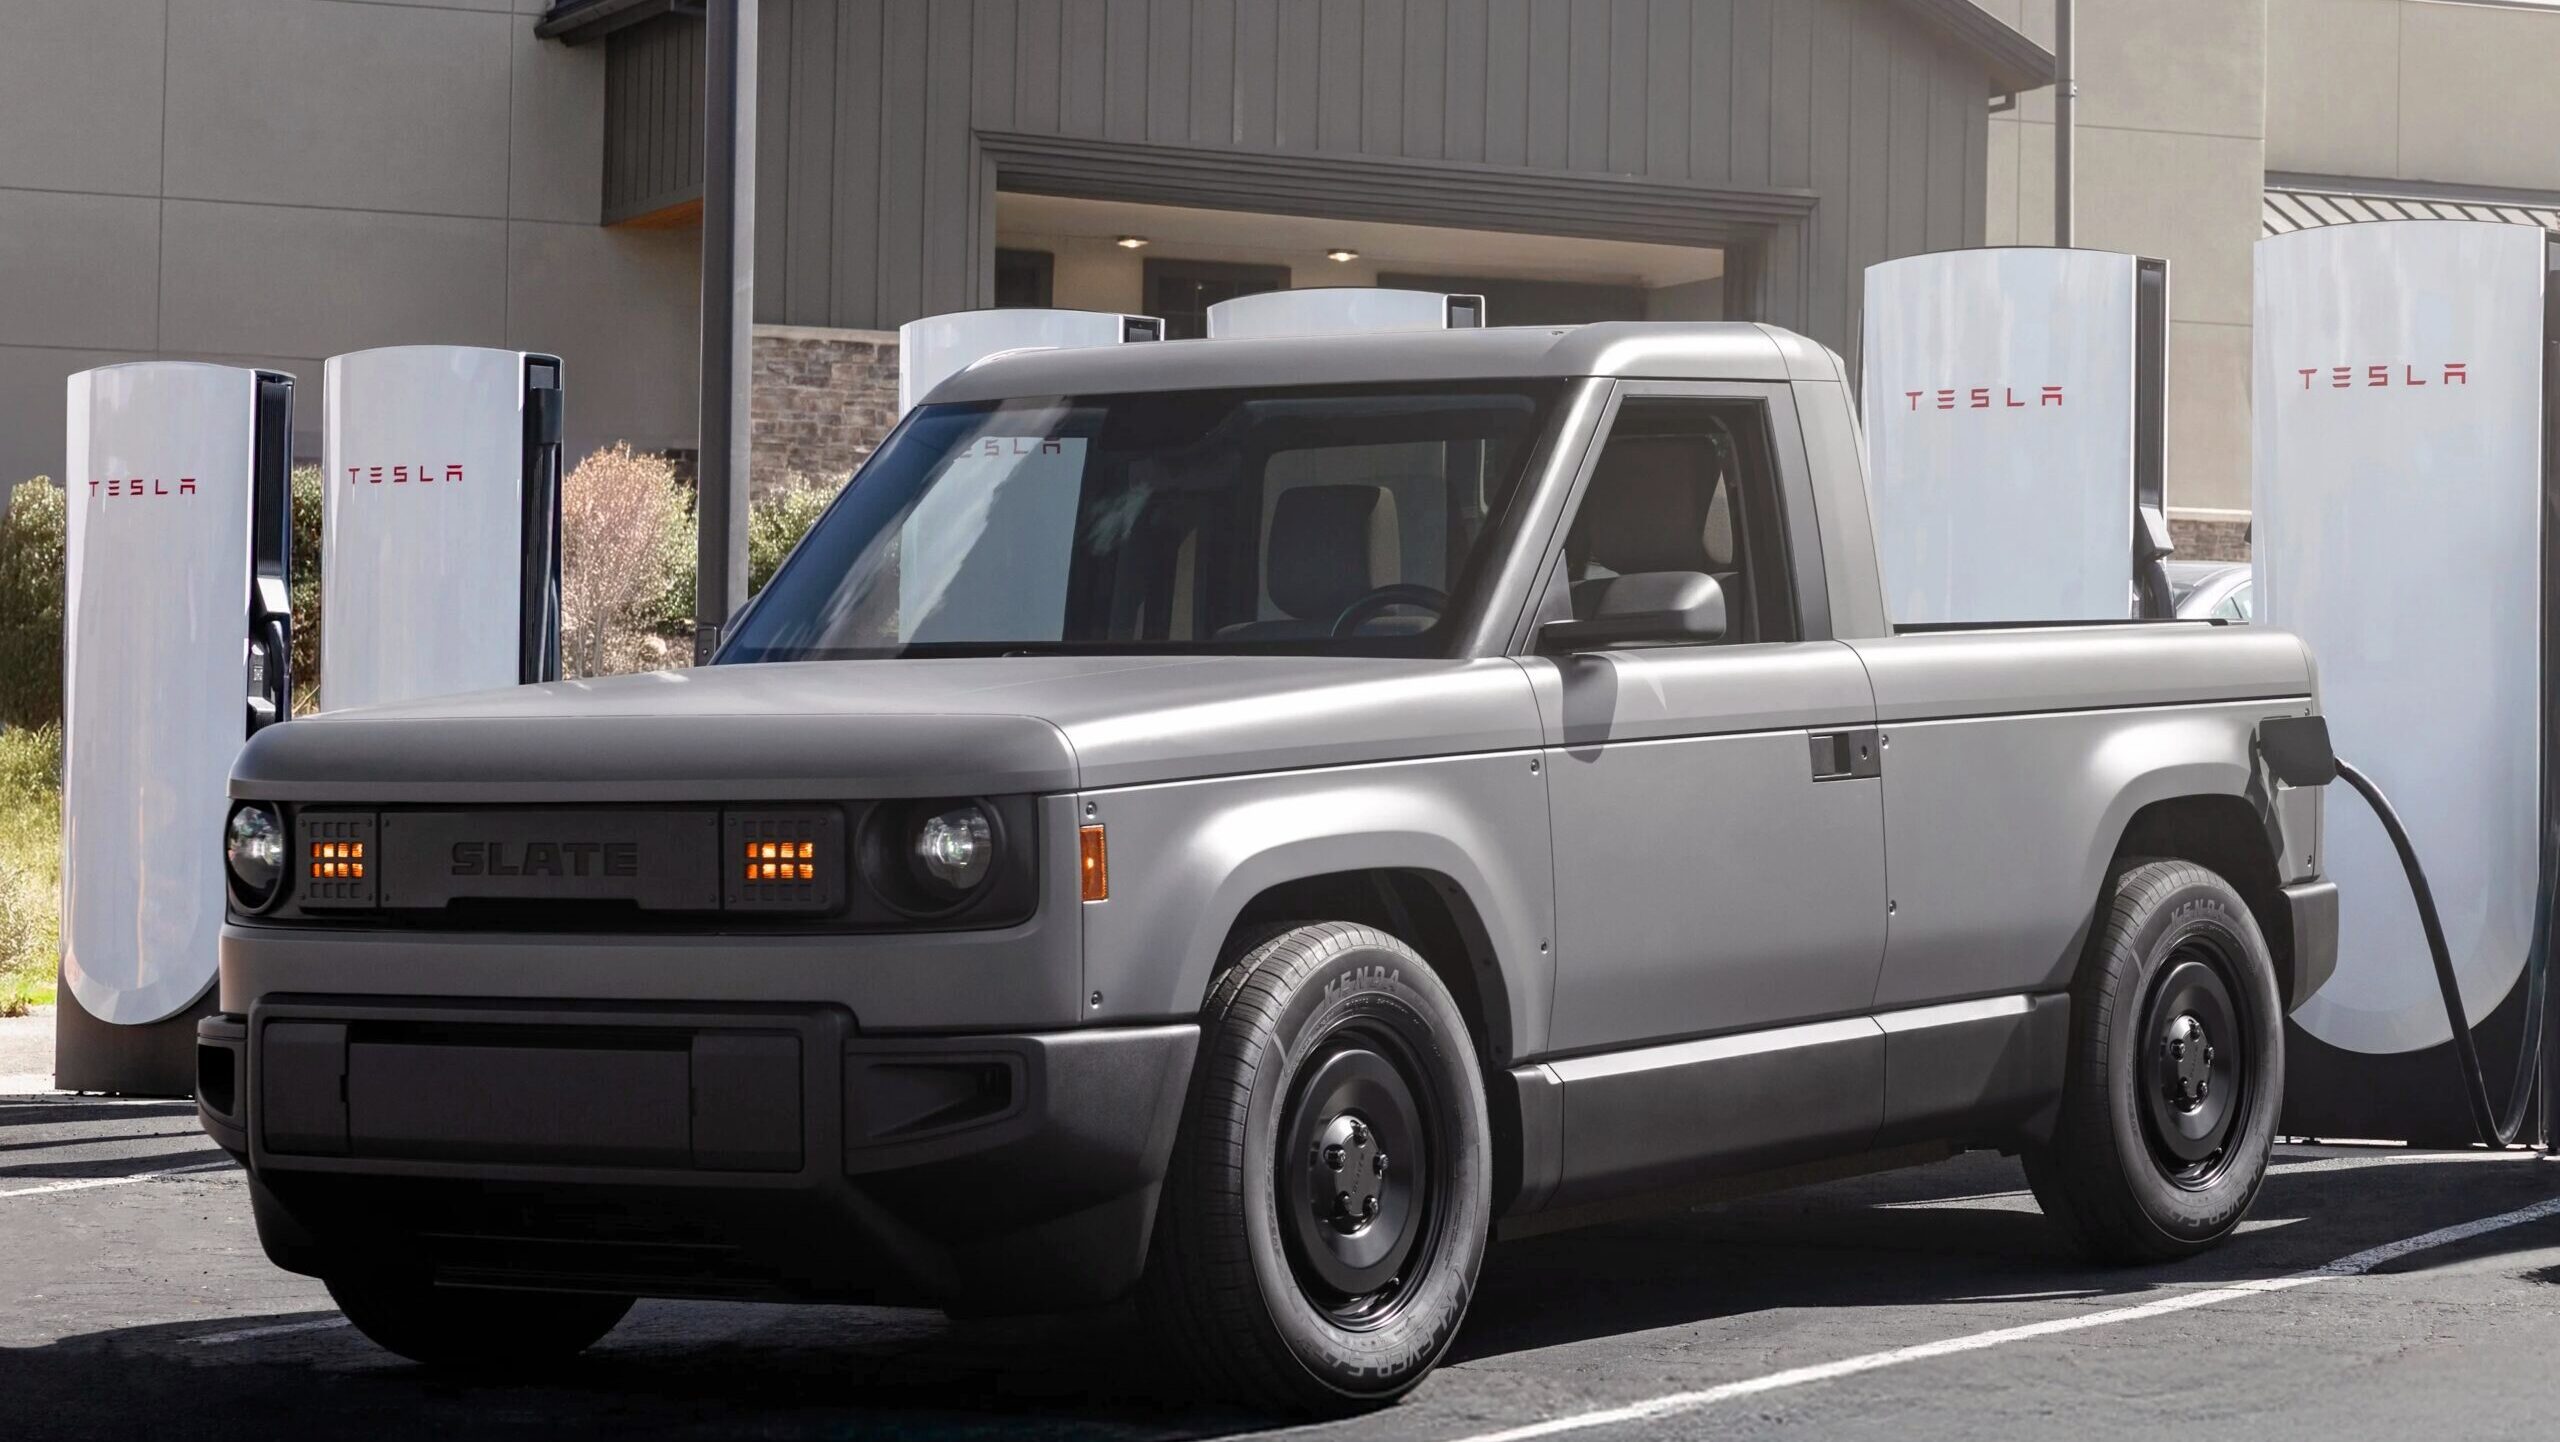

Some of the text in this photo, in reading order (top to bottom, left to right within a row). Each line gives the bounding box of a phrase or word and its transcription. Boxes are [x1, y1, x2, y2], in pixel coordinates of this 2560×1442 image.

[2298, 363, 2467, 390] TESLA
[1905, 386, 2064, 411] TESLA
[88, 478, 196, 497] TESLA
[347, 465, 463, 484] TESLA
[451, 841, 638, 876] SLATE
[1323, 965, 1400, 1004] KENDA
